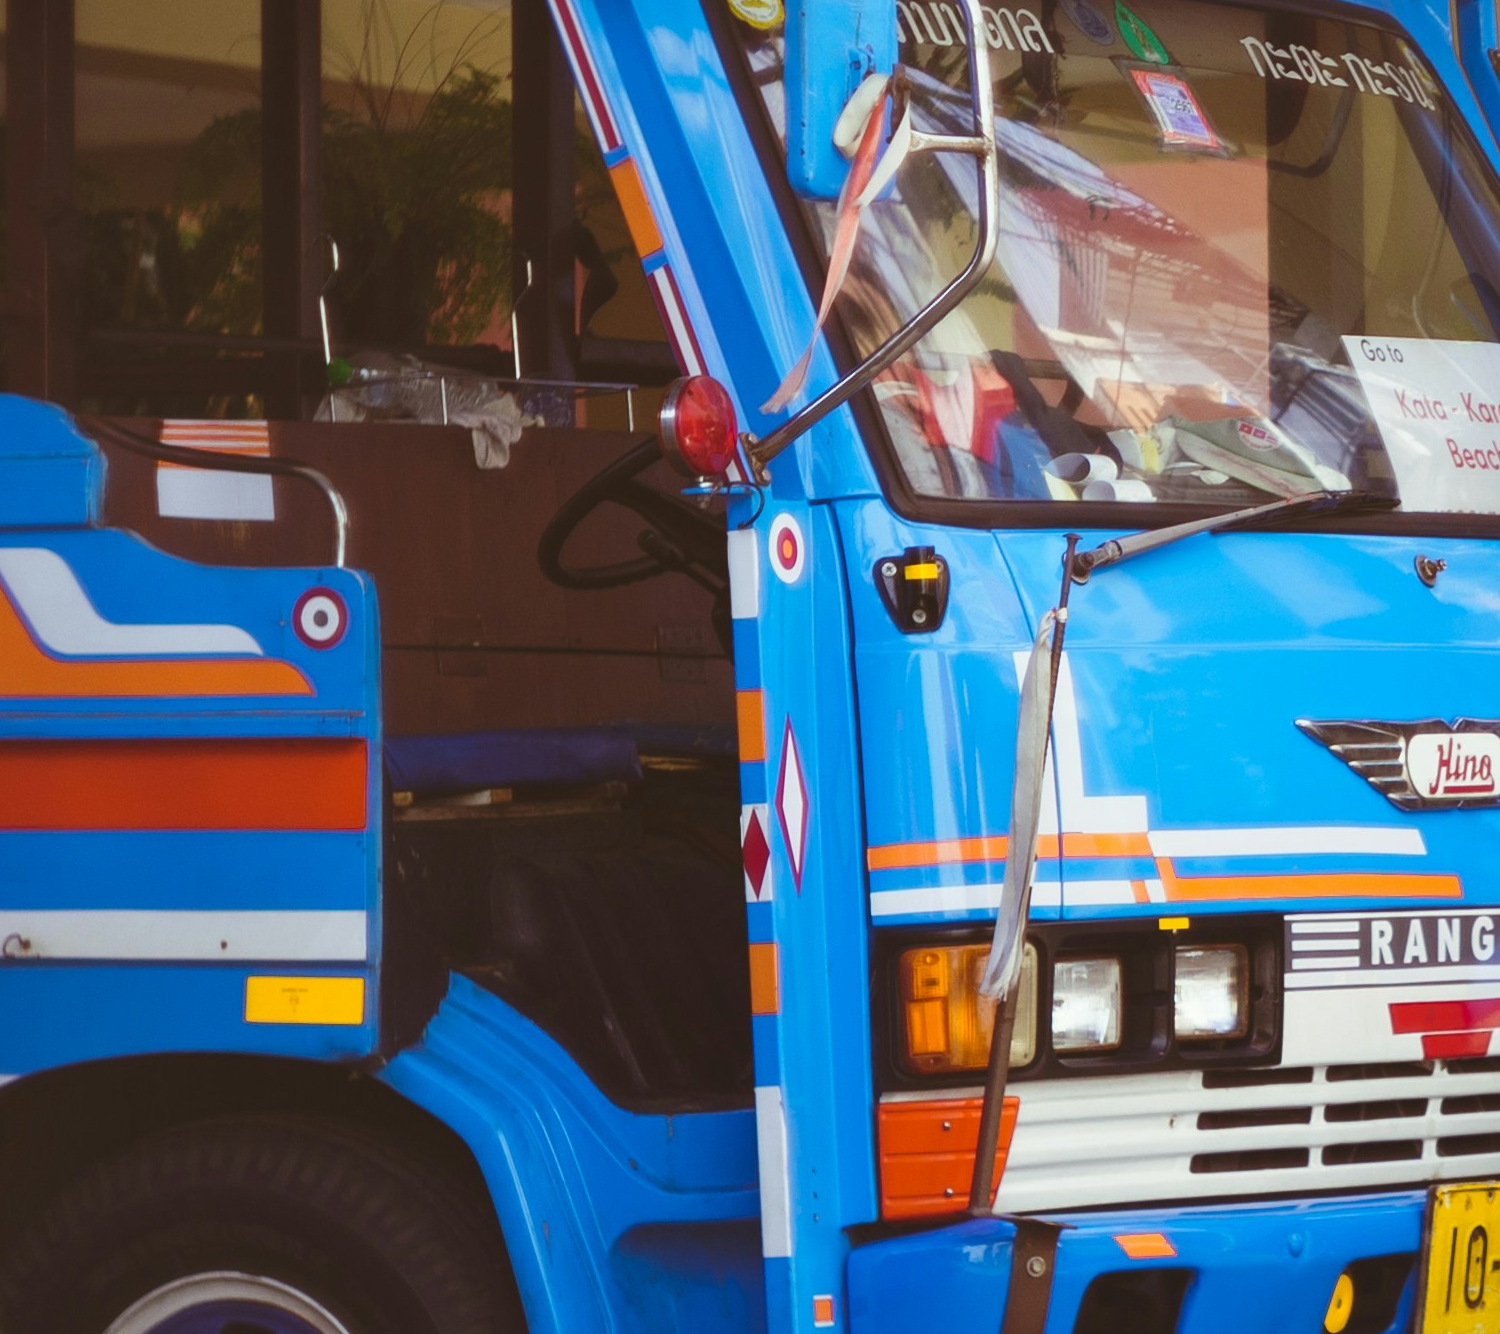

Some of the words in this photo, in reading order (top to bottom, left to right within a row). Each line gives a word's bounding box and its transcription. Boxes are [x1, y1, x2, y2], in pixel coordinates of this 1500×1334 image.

[1360, 339, 1387, 363] Go
[1386, 344, 1405, 365] to
[1393, 388, 1449, 421] Kata
[1429, 737, 1495, 796] Hino
